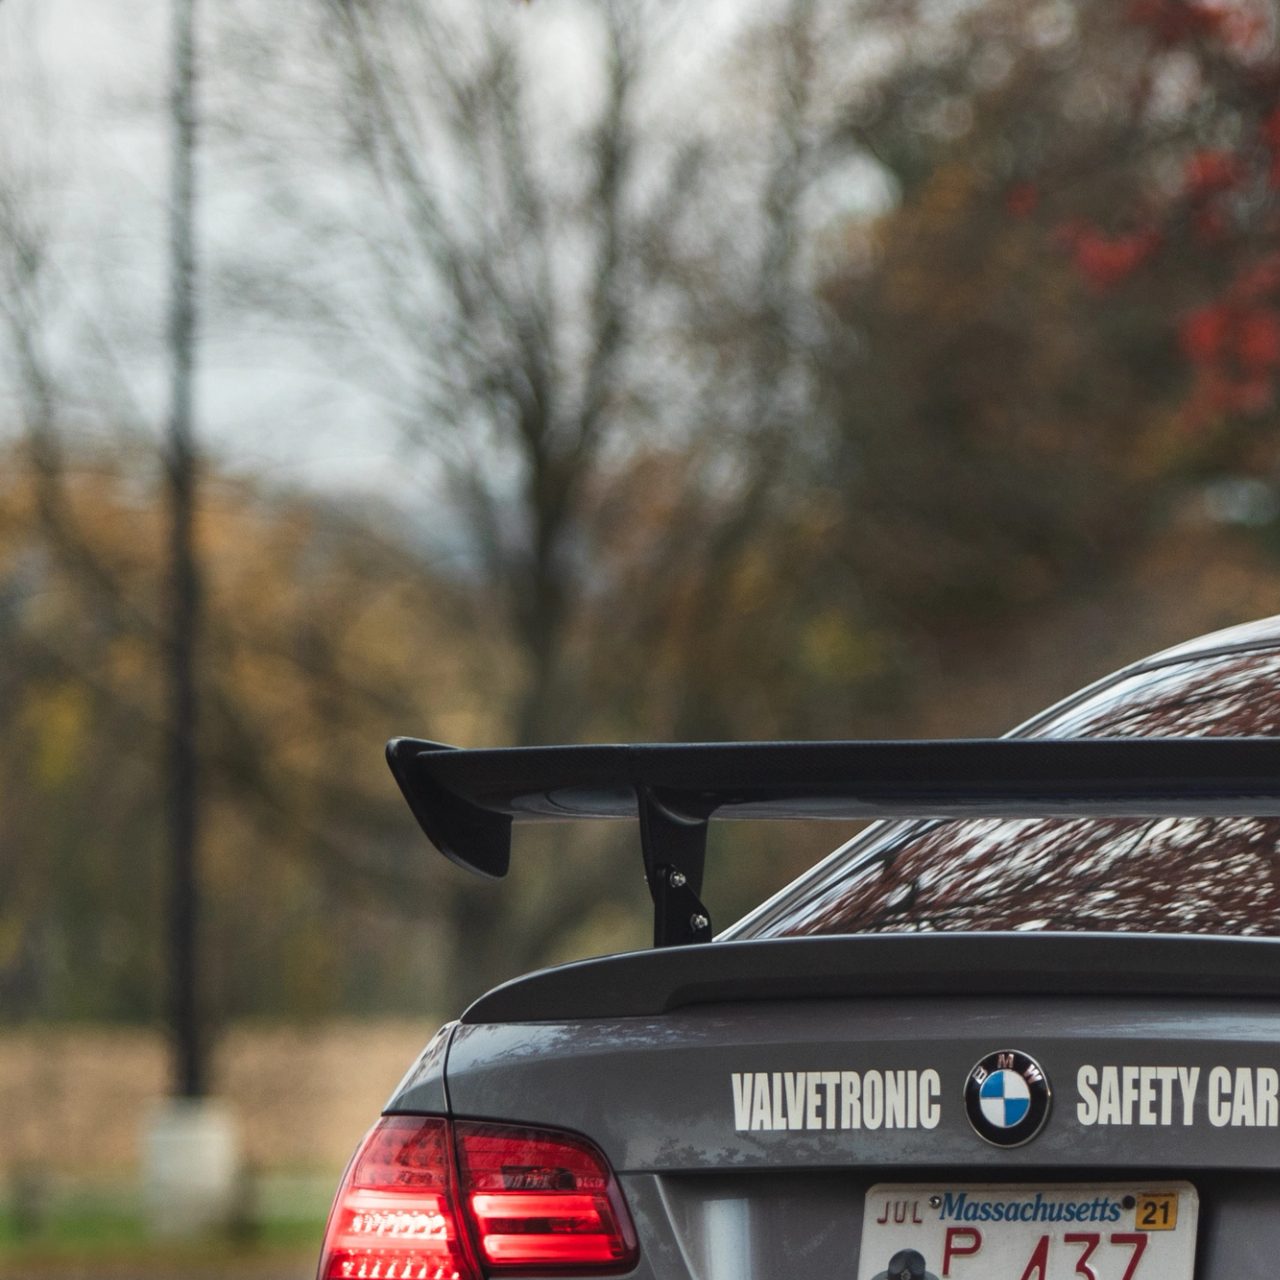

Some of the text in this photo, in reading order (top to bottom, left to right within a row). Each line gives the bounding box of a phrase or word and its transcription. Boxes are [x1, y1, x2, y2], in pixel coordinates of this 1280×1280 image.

[971, 1052, 1044, 1086] BMW
[731, 1064, 1279, 1131] VALVETRONIC SAFETY CAR
[877, 1200, 923, 1225] JUL
[939, 1192, 1122, 1223] Massachusetts
[1142, 1201, 1170, 1225] 21
